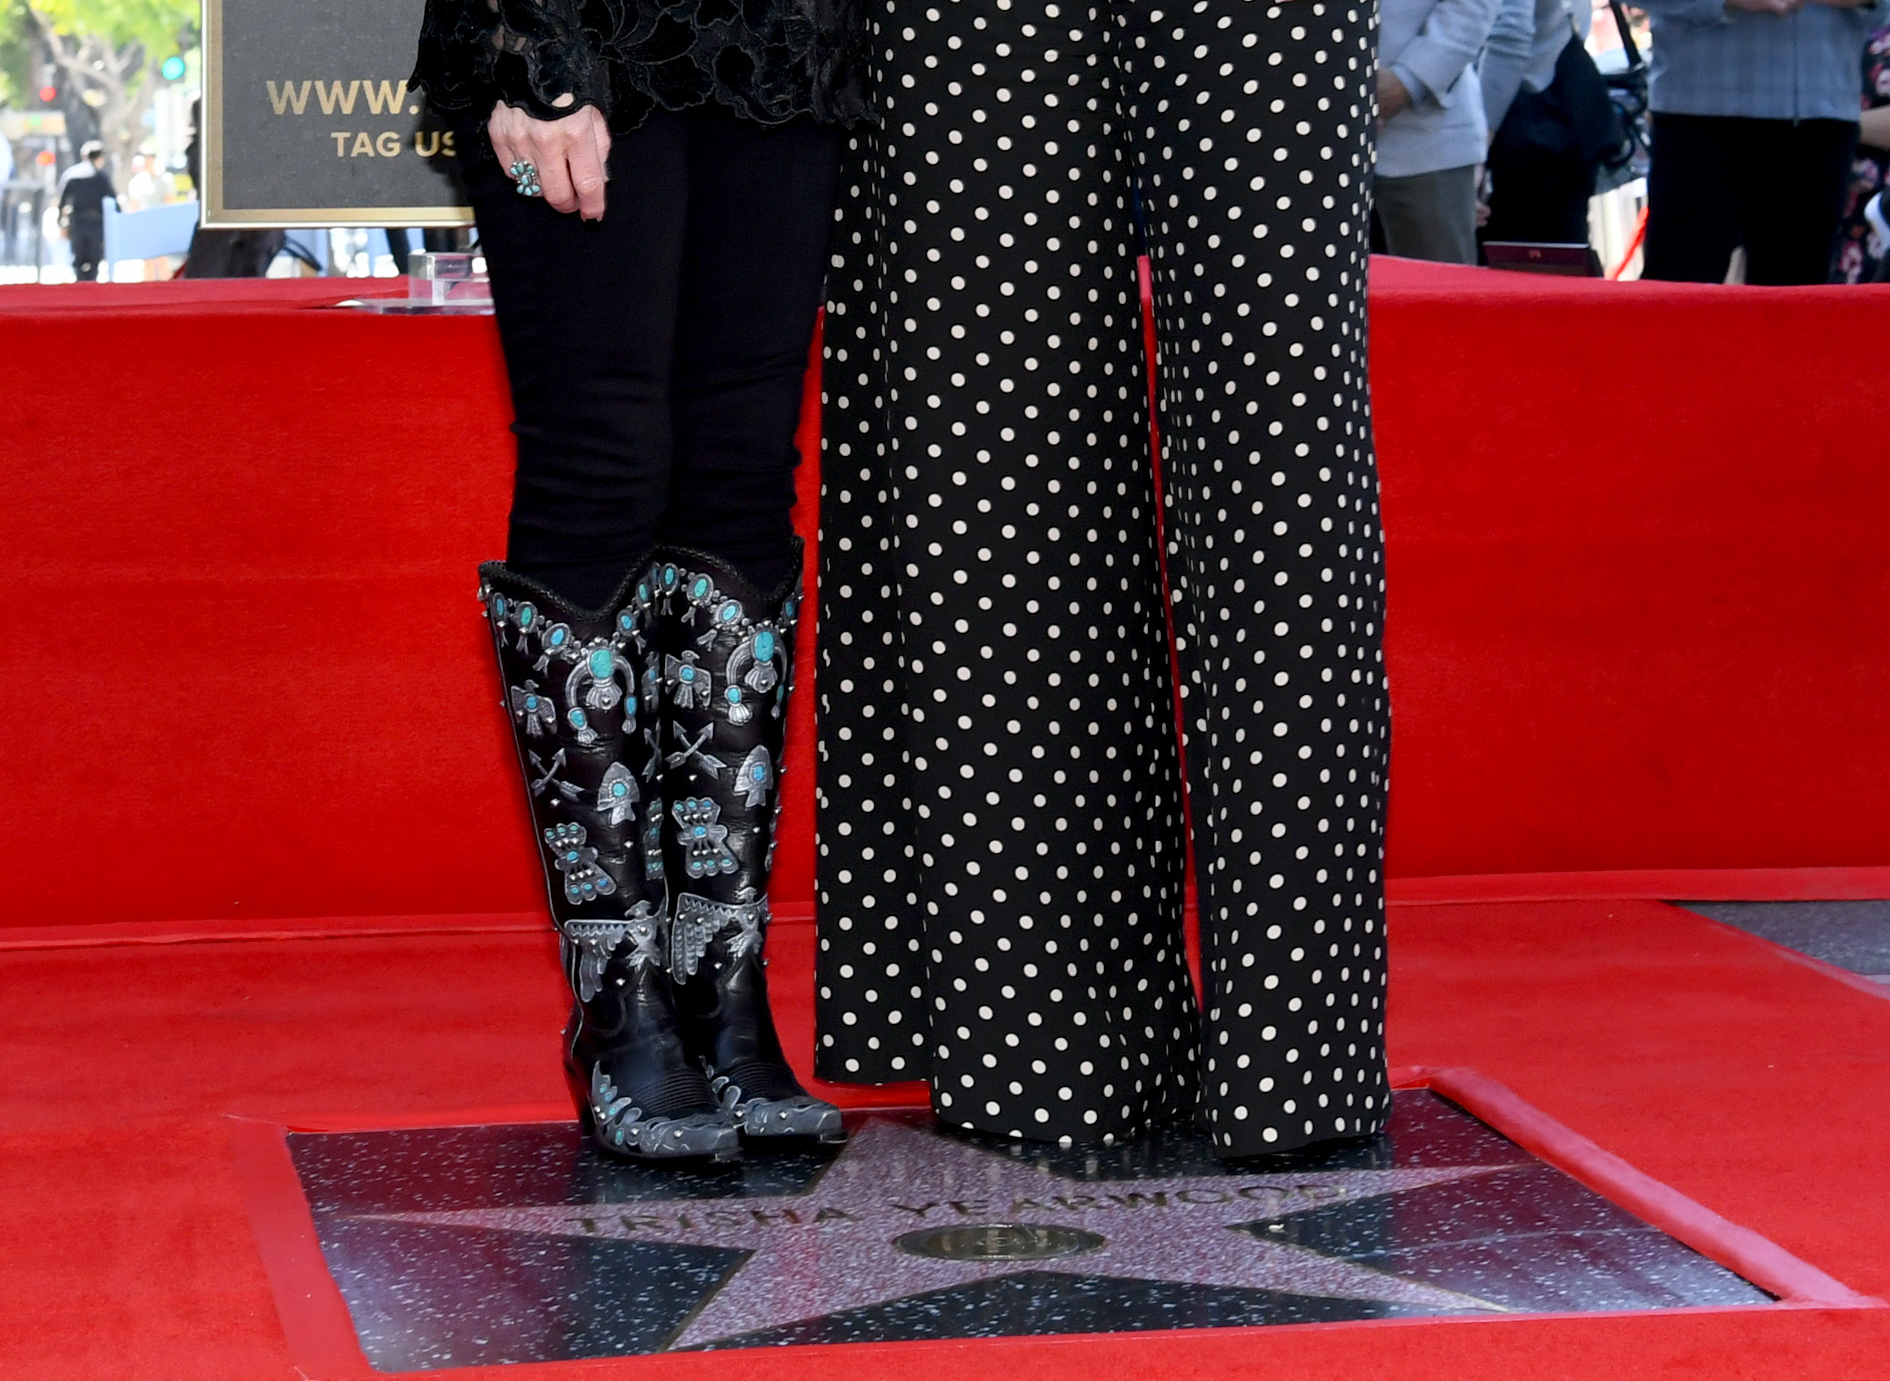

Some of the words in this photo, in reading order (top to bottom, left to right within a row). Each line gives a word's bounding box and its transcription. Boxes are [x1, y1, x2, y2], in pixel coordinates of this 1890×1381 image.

[331, 131, 400, 157] TAG
[568, 1207, 858, 1233] TRISHA
[890, 1184, 1347, 1217] YEARWOOD
